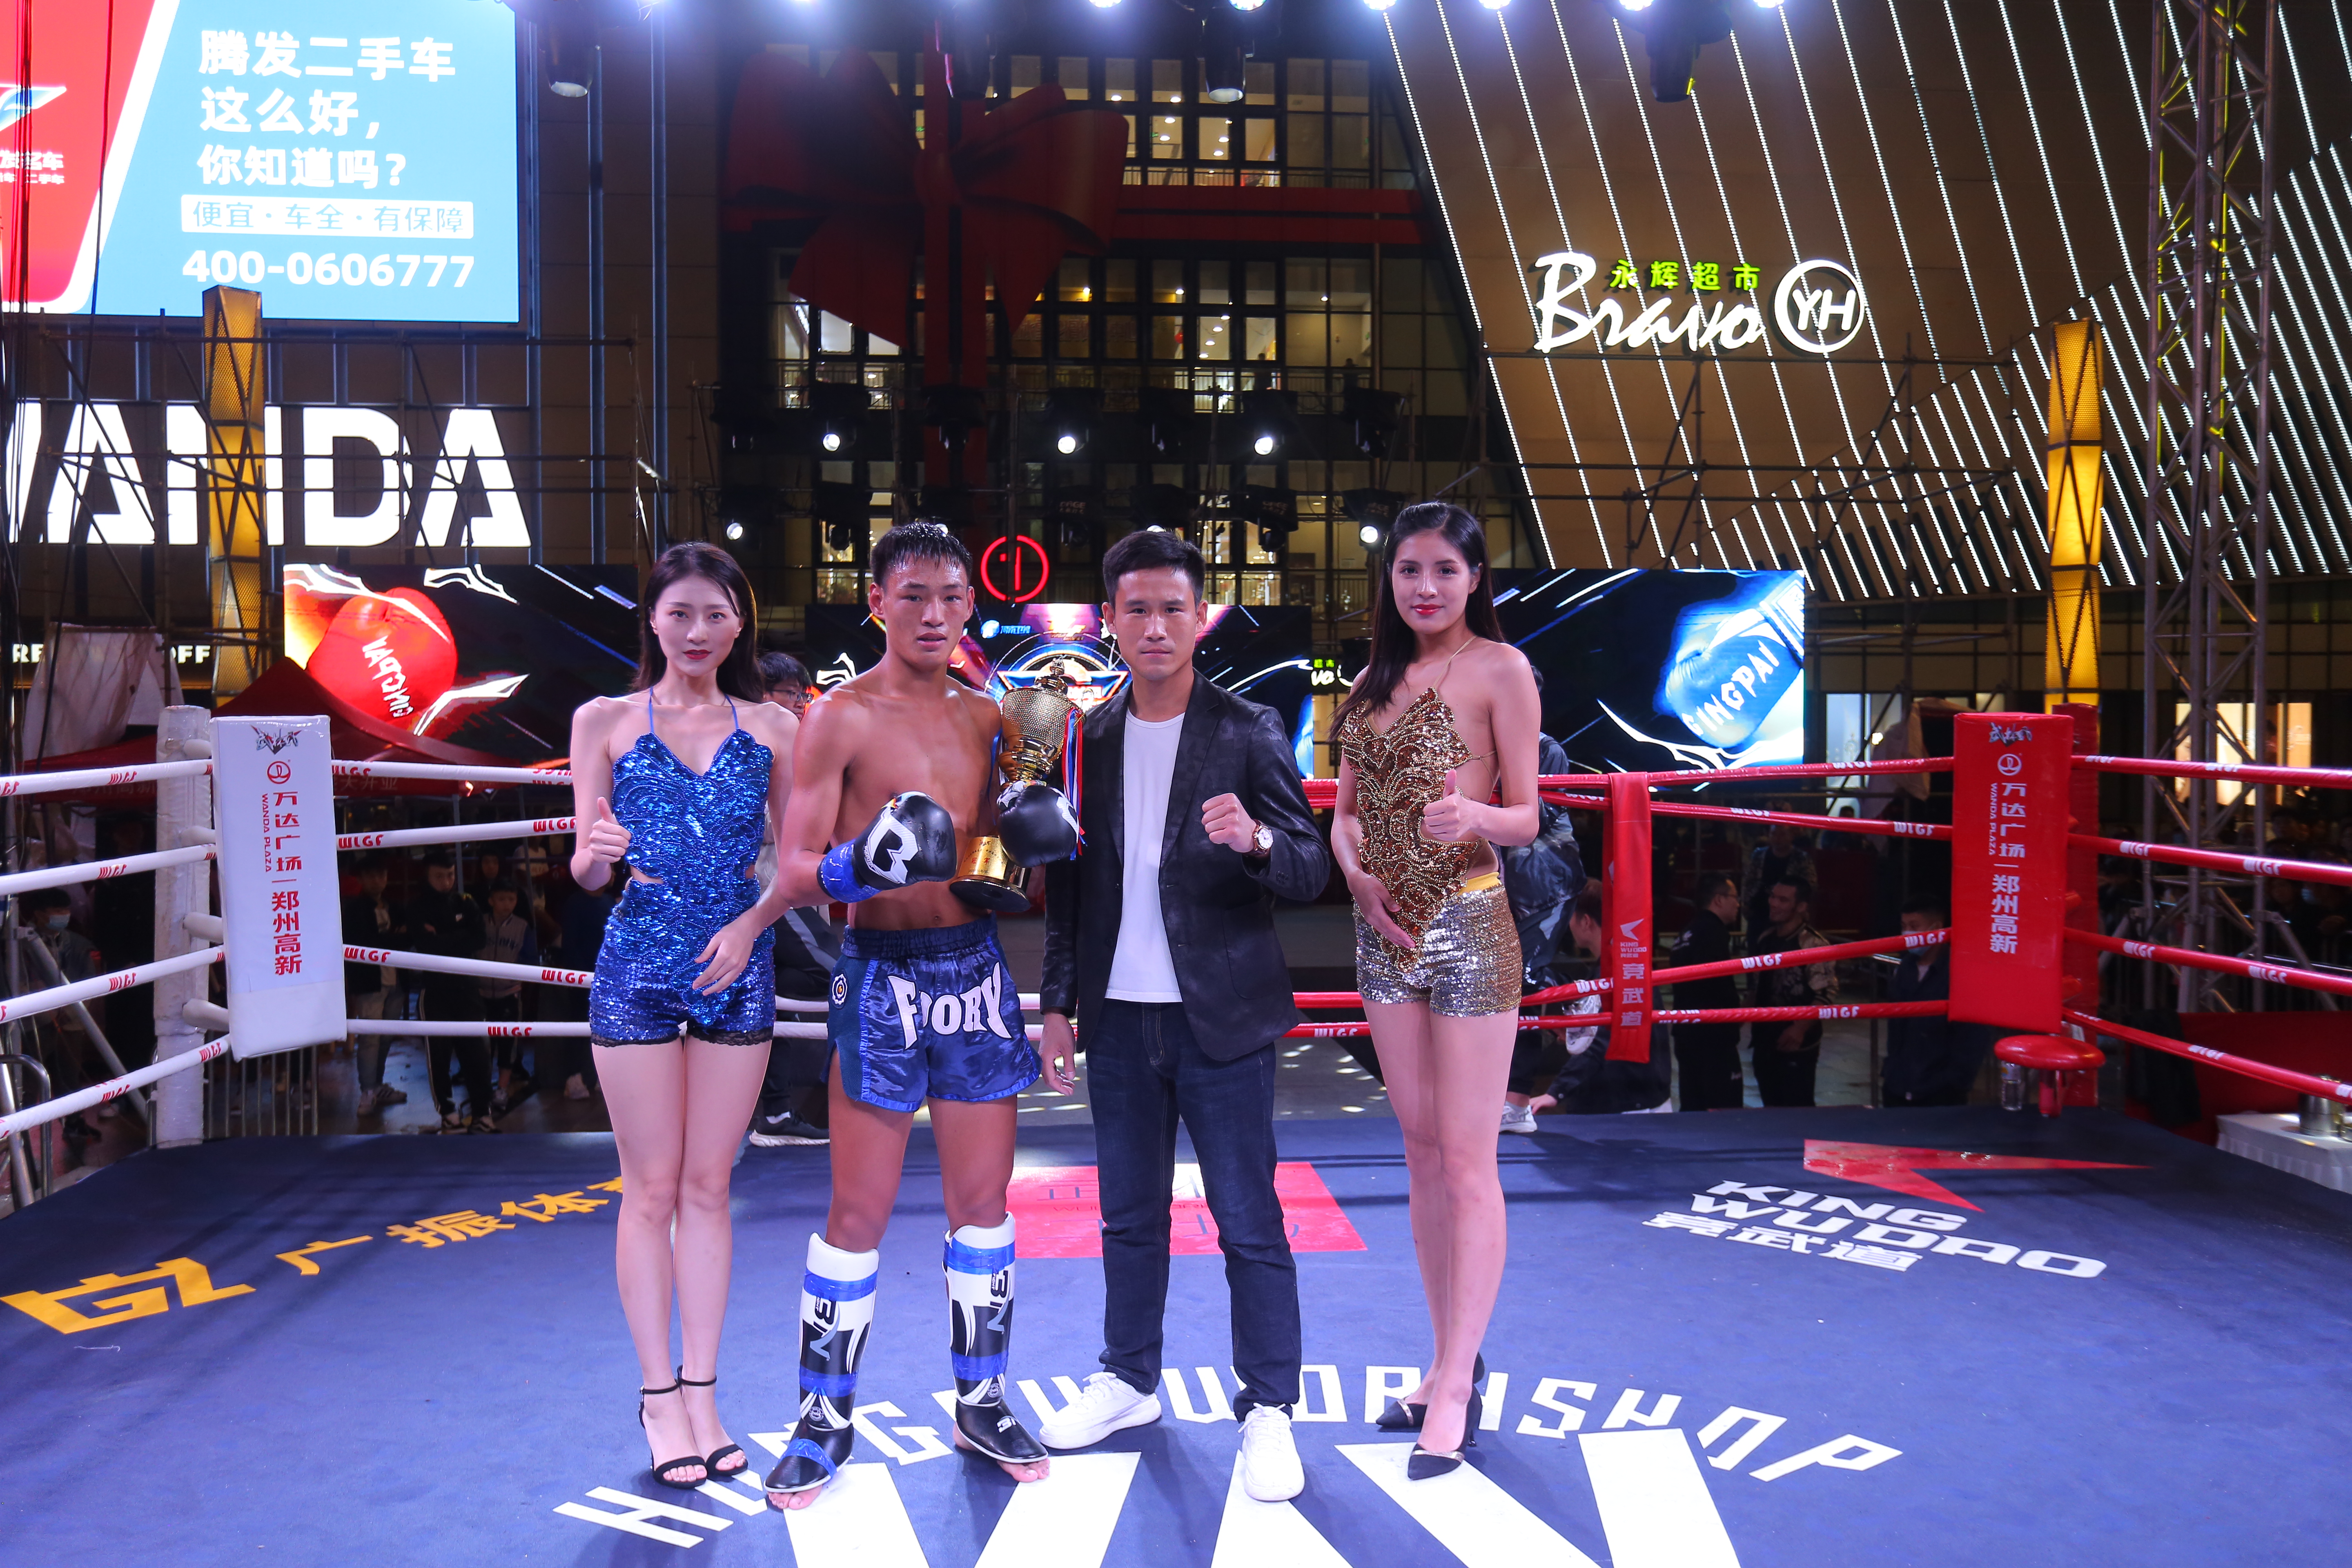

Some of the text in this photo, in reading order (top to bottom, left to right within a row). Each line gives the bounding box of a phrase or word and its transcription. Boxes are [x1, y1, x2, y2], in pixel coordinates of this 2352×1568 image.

[199, 29, 456, 82] 腾发二手车
[182, 250, 474, 287] 400-0606777
[1609, 259, 1761, 292] 永辉超市
[1534, 252, 1766, 352] Bravo
[1792, 289, 1856, 331] YH
[262, 793, 271, 833] WANDA
[533, 818, 576, 832] WLGF
[1893, 822, 1935, 835] WLGF
[1988, 782, 1998, 856] WANDA PLAZA
[339, 835, 383, 849] WLGF
[272, 791, 303, 976] 万达广场 郑州高新
[1989, 782, 2027, 954] 万达广场 郑州高新
[345, 947, 391, 962] WLGF
[1904, 931, 1946, 947] WLGF
[541, 969, 587, 984] WLGF
[1740, 954, 1782, 969] WLGF
[1818, 1006, 1860, 1019] WLGF
[1707, 1180, 1967, 1232] KING
